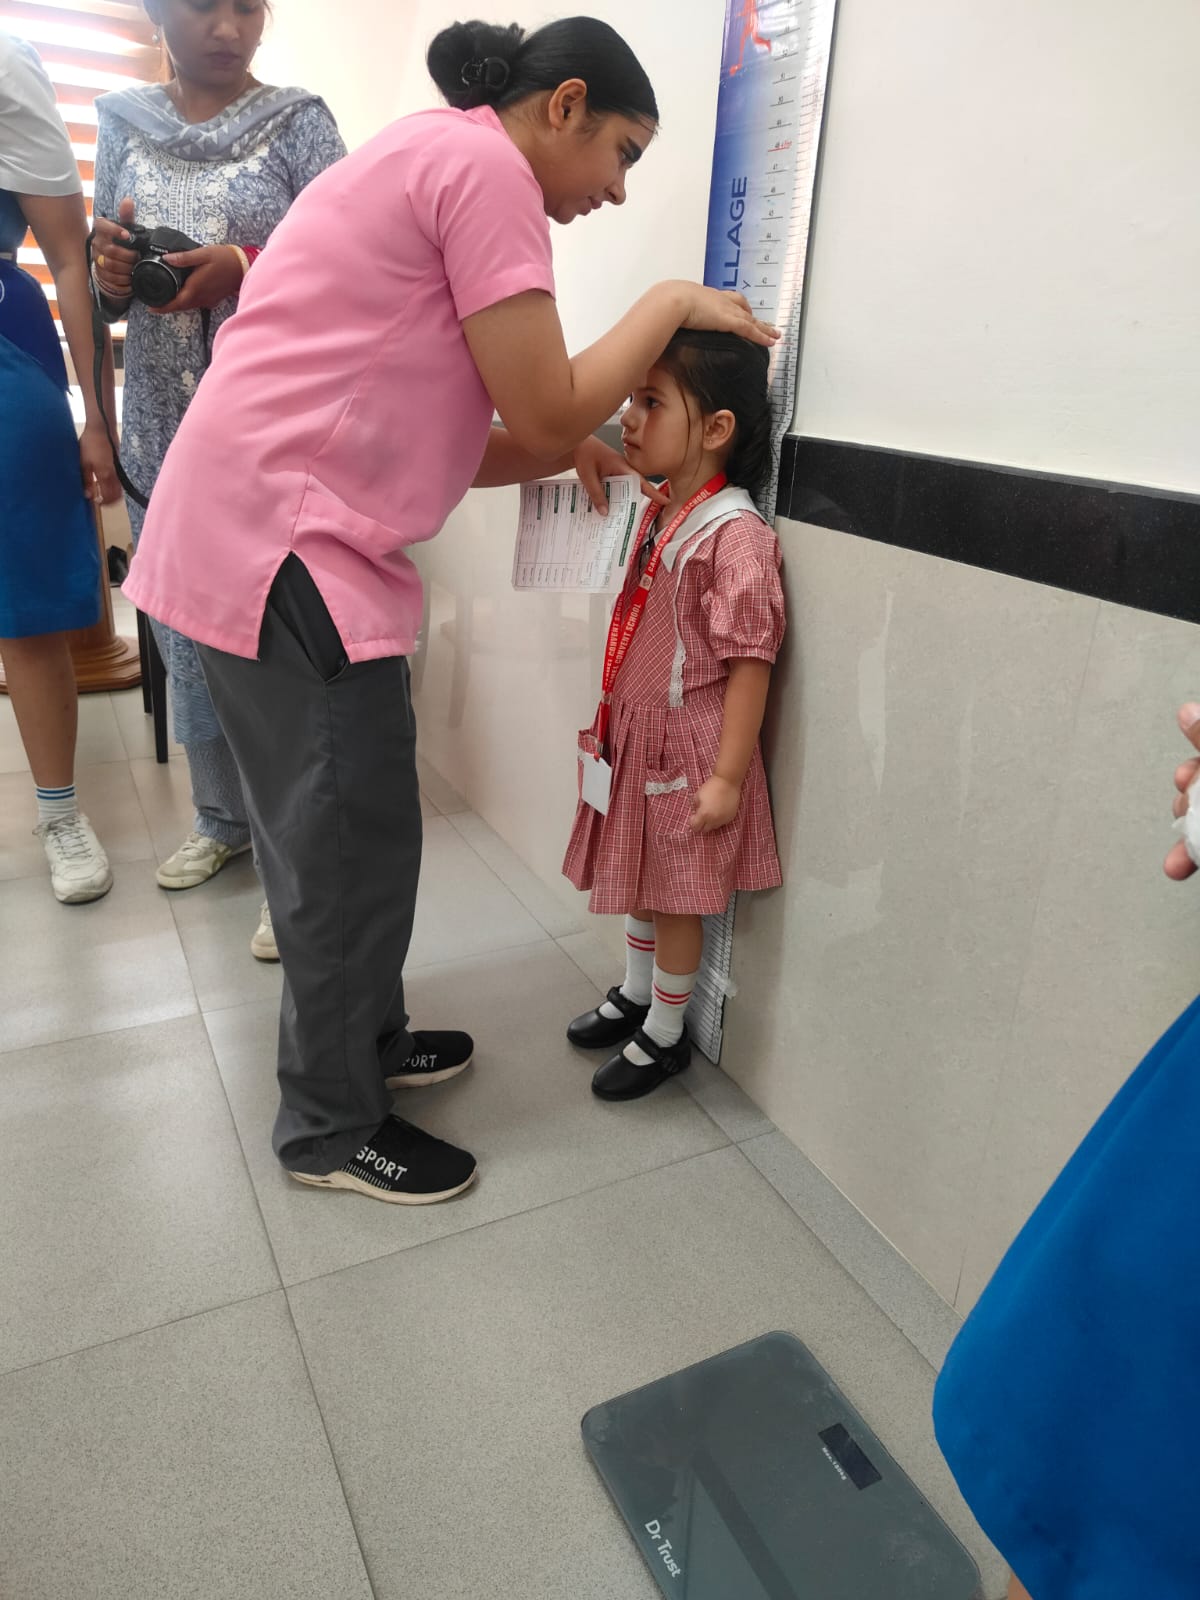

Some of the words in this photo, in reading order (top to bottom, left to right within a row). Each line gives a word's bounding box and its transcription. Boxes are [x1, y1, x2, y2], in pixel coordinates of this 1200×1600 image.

[722, 176, 748, 289] LLAGE
[647, 541, 663, 572] CARMEL
[662, 510, 686, 542] CONVENT
[684, 488, 712, 513] SCHOOL
[608, 622, 619, 657] CONVENT
[615, 632, 631, 664] CONVENT
[625, 603, 642, 632] SCHOOL
[402, 1054, 437, 1068] ORT
[356, 1146, 407, 1181] SPORT
[645, 1520, 661, 1539] Dr
[658, 1539, 681, 1578] Trust
